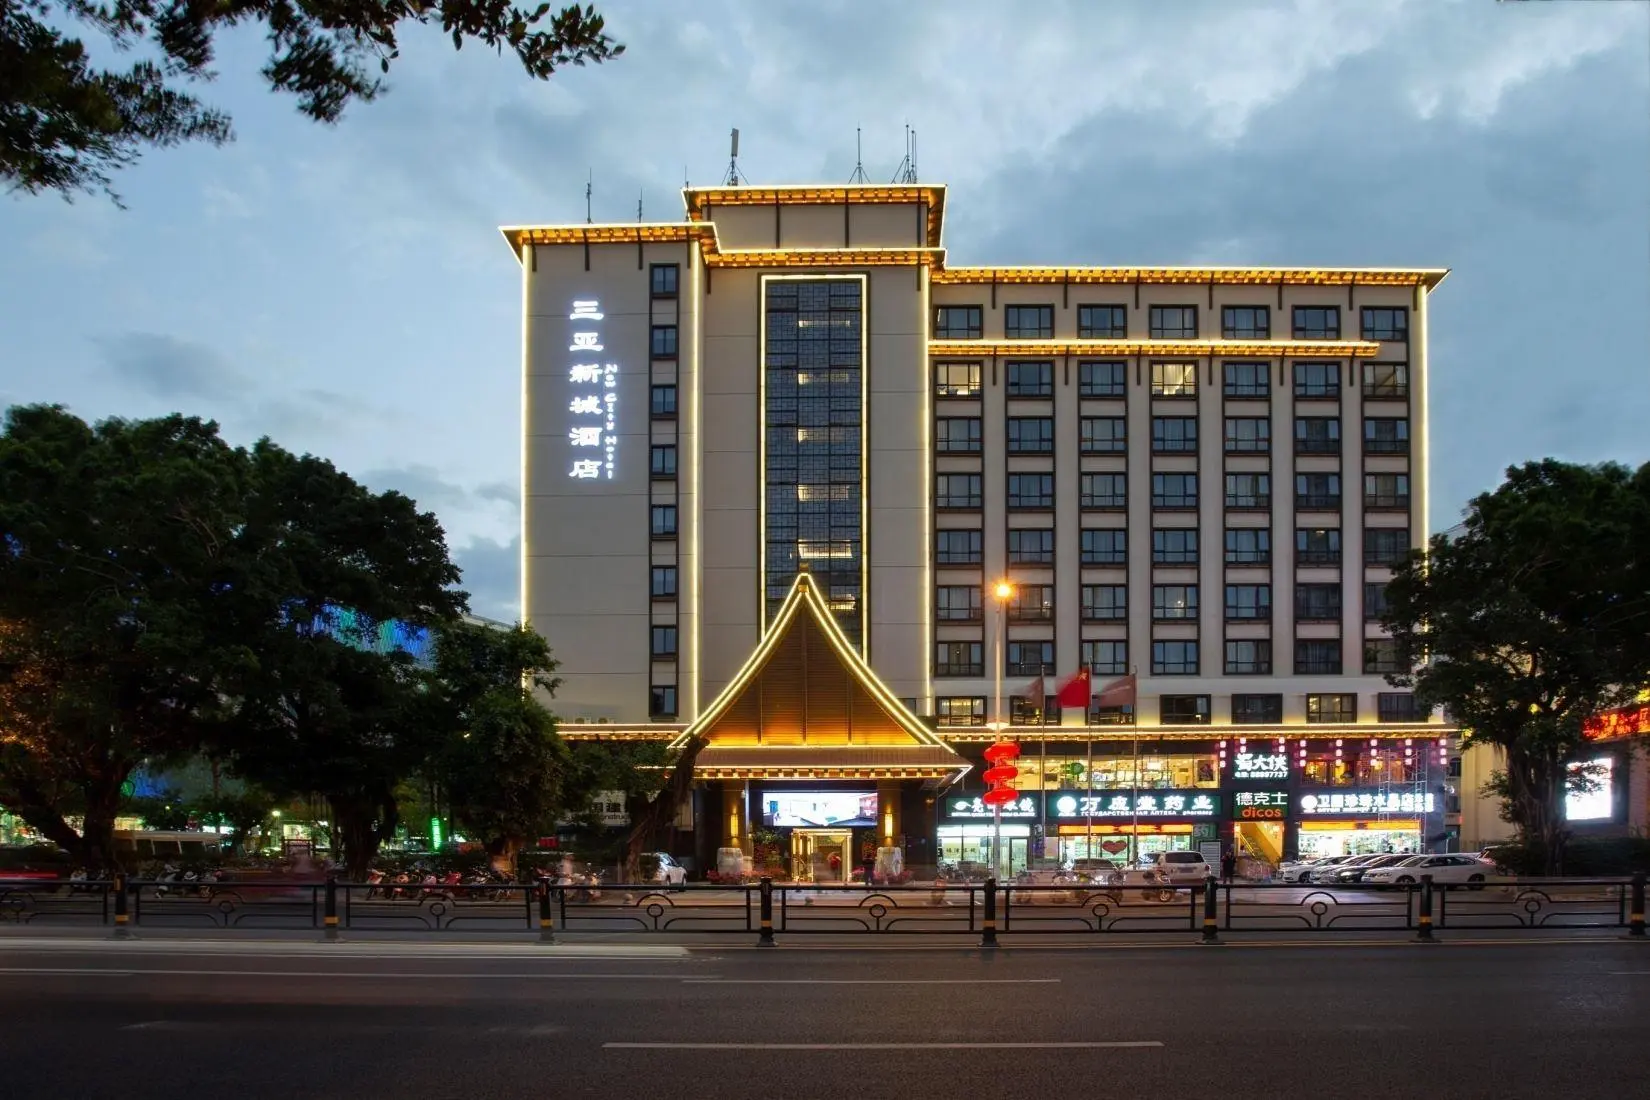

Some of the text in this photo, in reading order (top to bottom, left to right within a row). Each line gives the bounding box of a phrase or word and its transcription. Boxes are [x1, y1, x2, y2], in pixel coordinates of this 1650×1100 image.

[569, 300, 604, 479] 三亚新城酒店
[1236, 791, 1288, 806] 德克士
[1242, 806, 1281, 818] dicos
